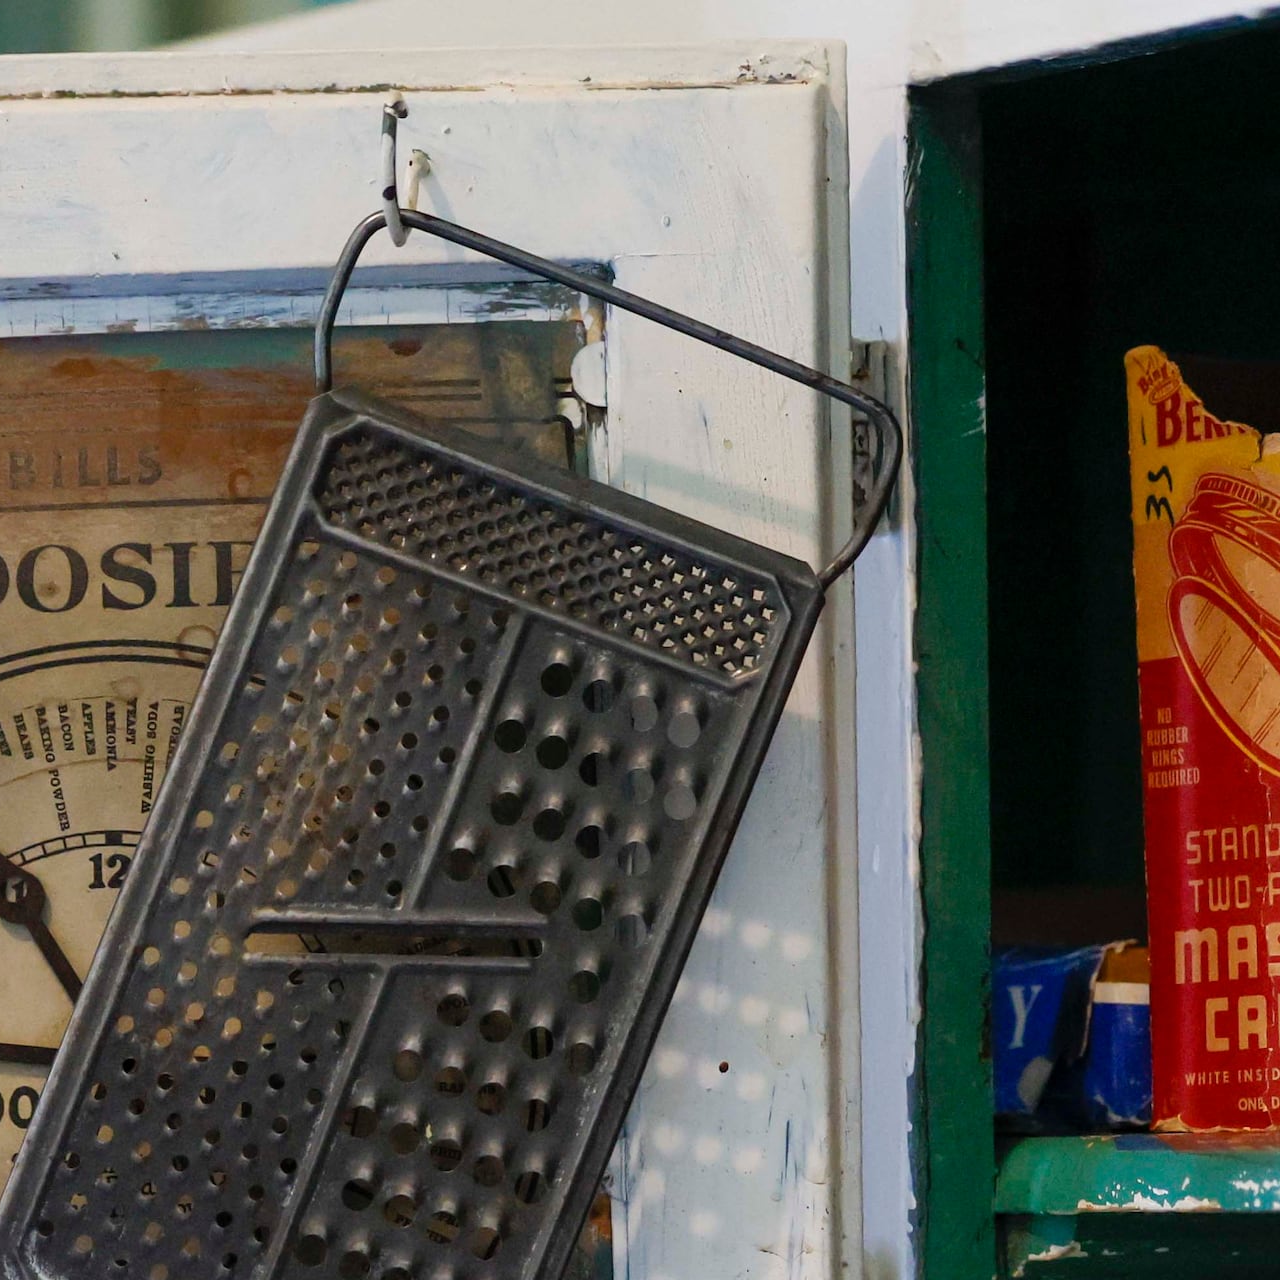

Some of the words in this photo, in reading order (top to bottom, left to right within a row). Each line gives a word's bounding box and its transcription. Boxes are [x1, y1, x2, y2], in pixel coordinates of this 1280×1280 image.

[9, 446, 162, 490] BILLS
[58, 703, 74, 752] BACON
[81, 702, 96, 756] APPLES
[147, 701, 159, 740] SODA
[1157, 706, 1173, 725] NO
[13, 713, 34, 760] BEANS
[1146, 725, 1189, 747] RUBBER
[1151, 747, 1185, 768] RINGS
[1147, 767, 1200, 789] REQUIRED
[48, 768, 70, 832] POWDER
[88, 853, 132, 890] 12
[1006, 984, 1044, 1050] Y
[1185, 1070, 1231, 1087] WHITE
[1238, 1096, 1267, 1112] ONE
